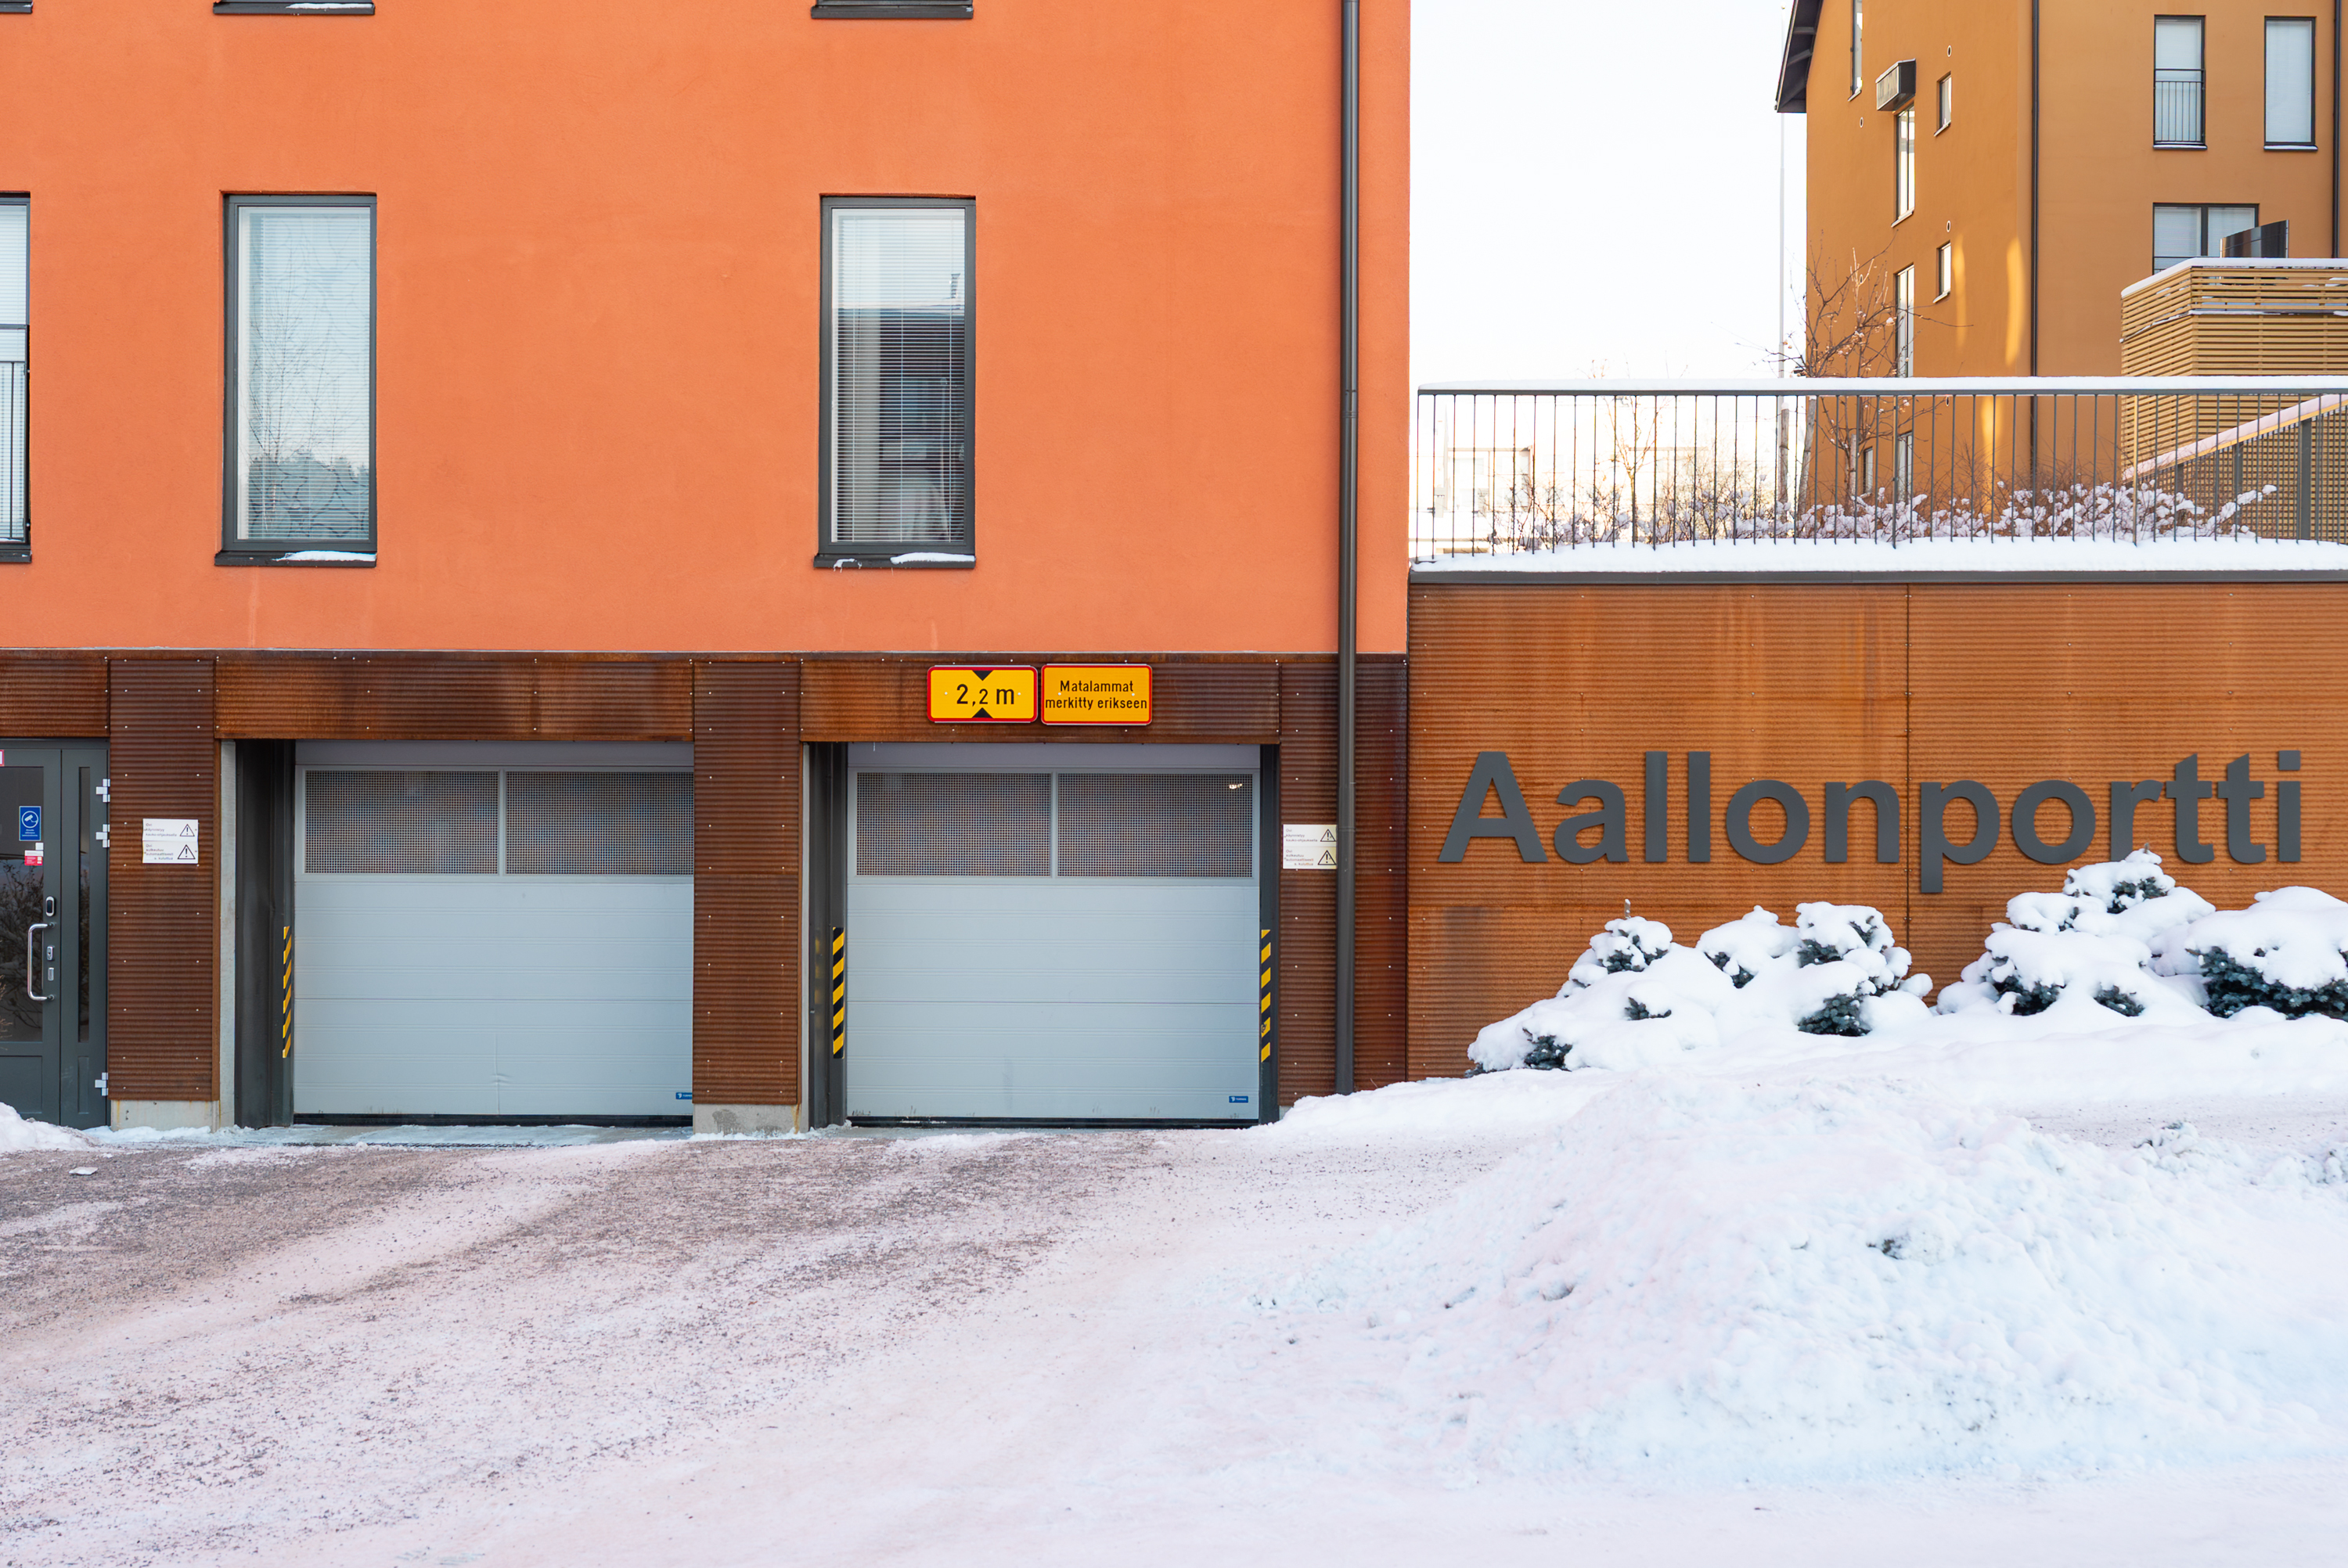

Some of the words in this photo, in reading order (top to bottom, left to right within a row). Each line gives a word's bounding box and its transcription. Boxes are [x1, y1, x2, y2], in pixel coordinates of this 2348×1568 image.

[1059, 679, 1134, 692] Matalammat
[996, 687, 1015, 705] m
[1045, 696, 1093, 710] merkitty
[1097, 696, 1147, 709] erikseen
[1438, 750, 2301, 893] Aallonportti
